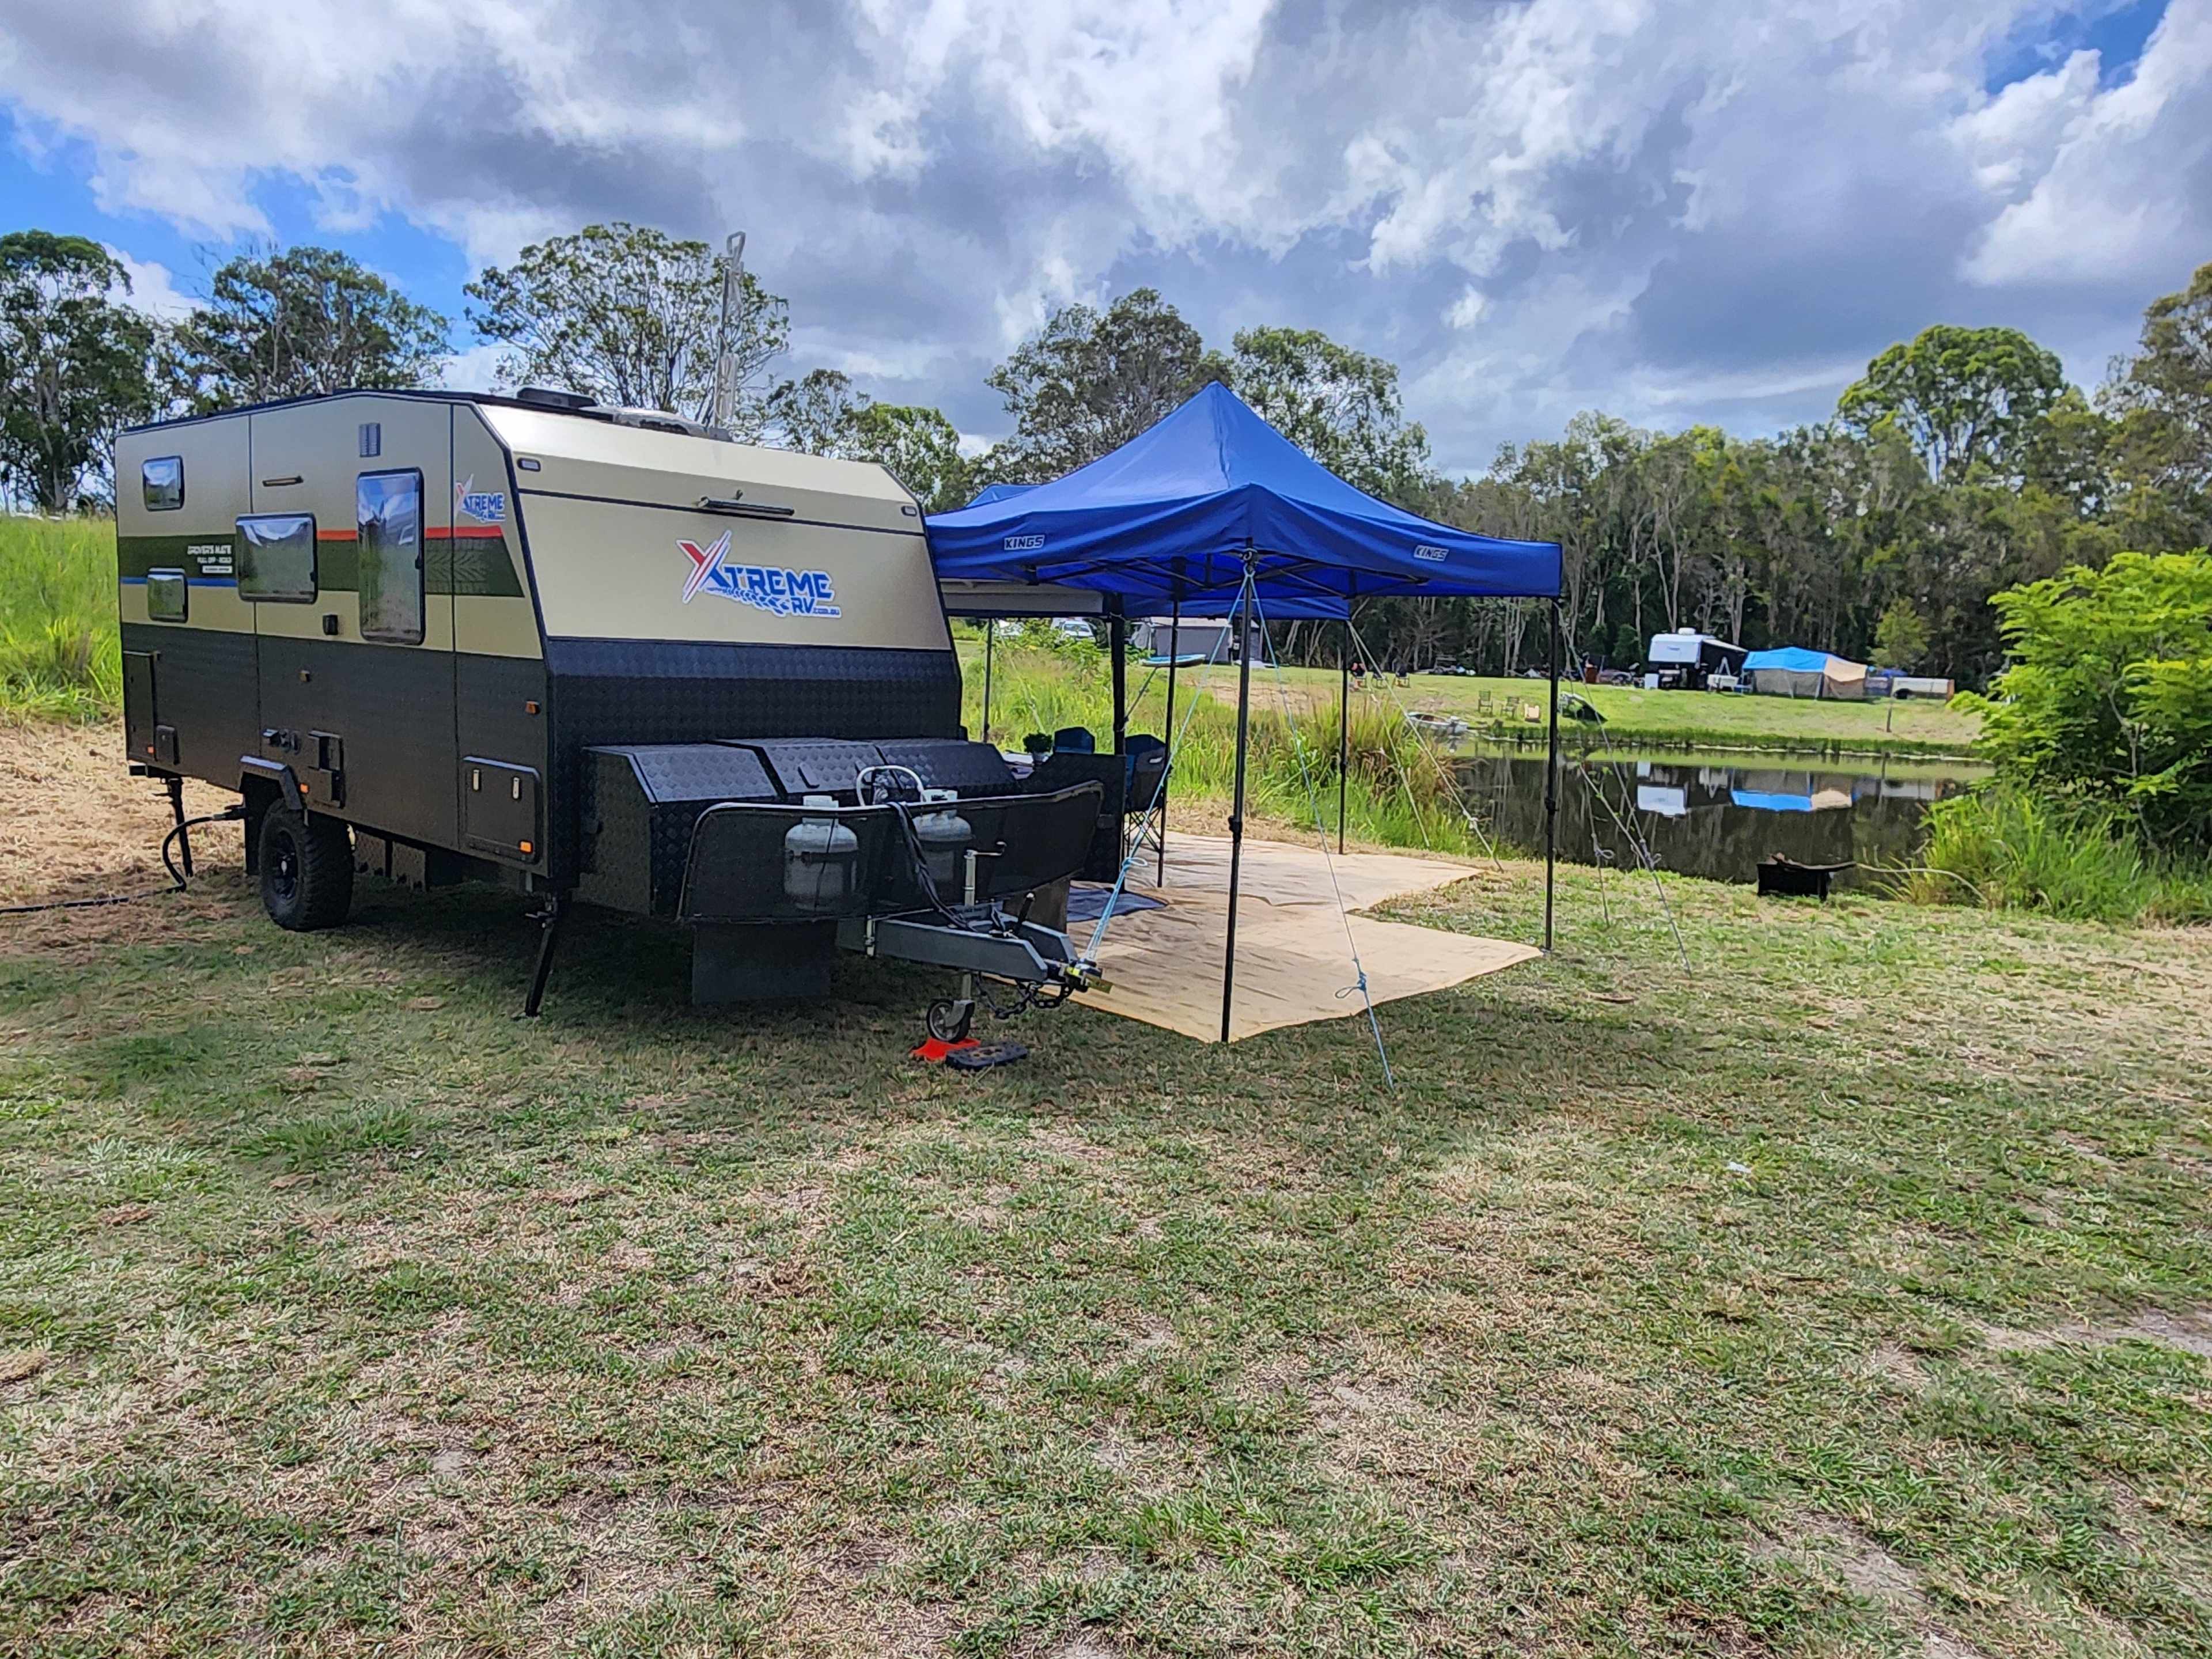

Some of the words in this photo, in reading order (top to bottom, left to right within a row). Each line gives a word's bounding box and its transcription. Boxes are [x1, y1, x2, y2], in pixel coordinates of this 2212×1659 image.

[1005, 537, 1043, 549] KINGS
[1416, 547, 1448, 559] KINGS
[678, 531, 833, 601] XTREME
[791, 597, 815, 614] RV
